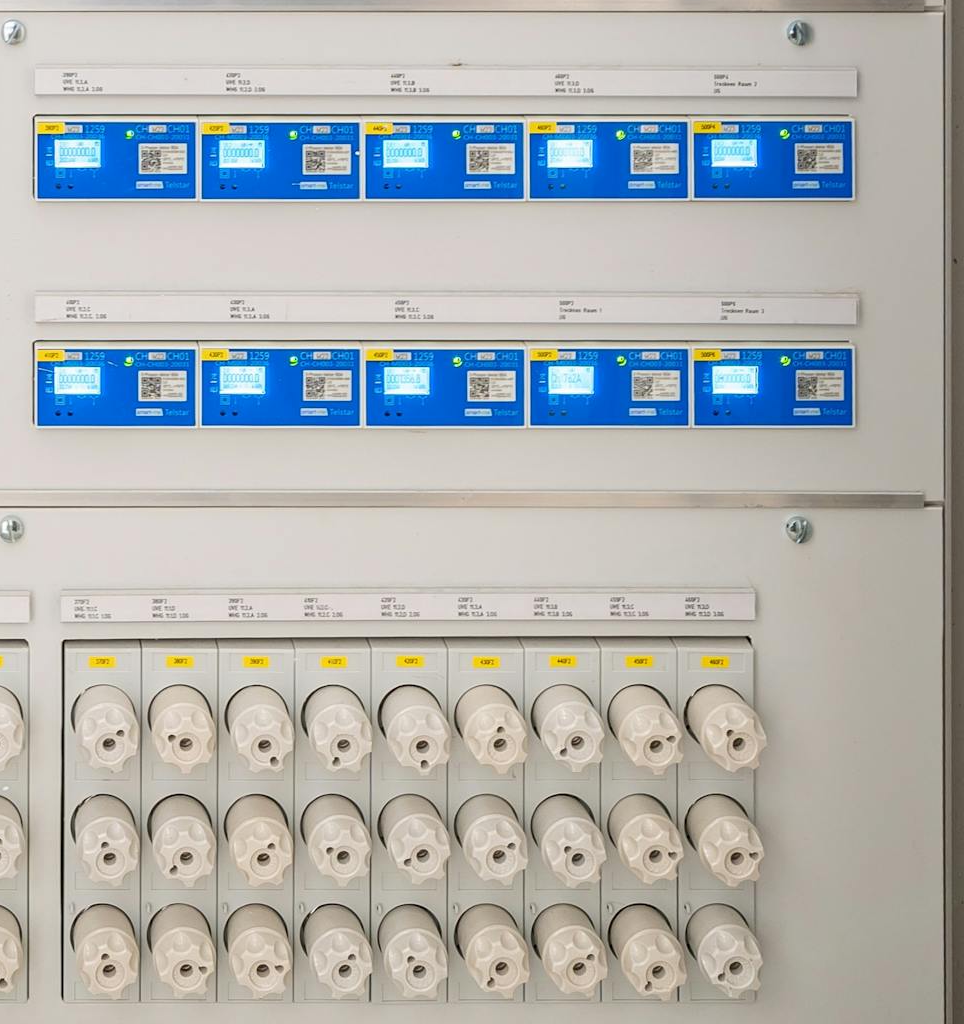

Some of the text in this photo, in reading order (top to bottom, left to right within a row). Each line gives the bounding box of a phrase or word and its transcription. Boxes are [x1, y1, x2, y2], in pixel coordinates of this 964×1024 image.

[85, 125, 105, 133] 1259
[136, 125, 190, 133] CH CH01
[249, 125, 269, 134] 1259
[300, 125, 354, 134] CH CH01
[413, 125, 433, 134] 1259
[463, 125, 517, 134] CH CH01
[577, 125, 597, 133] 1259
[627, 125, 681, 133] CH CH01
[741, 125, 761, 133] 1259
[791, 125, 845, 133] CH CH01
[84, 351, 105, 360] 1259
[135, 351, 190, 360] CH CH01
[249, 351, 270, 360] 1259
[300, 351, 354, 360] CH CH01
[414, 352, 434, 360] 1259
[464, 352, 518, 360] CH CH01
[578, 351, 598, 360] 1259
[628, 351, 683, 360] CH CH01
[742, 351, 763, 360] 1259
[792, 351, 847, 360] CH CH01
